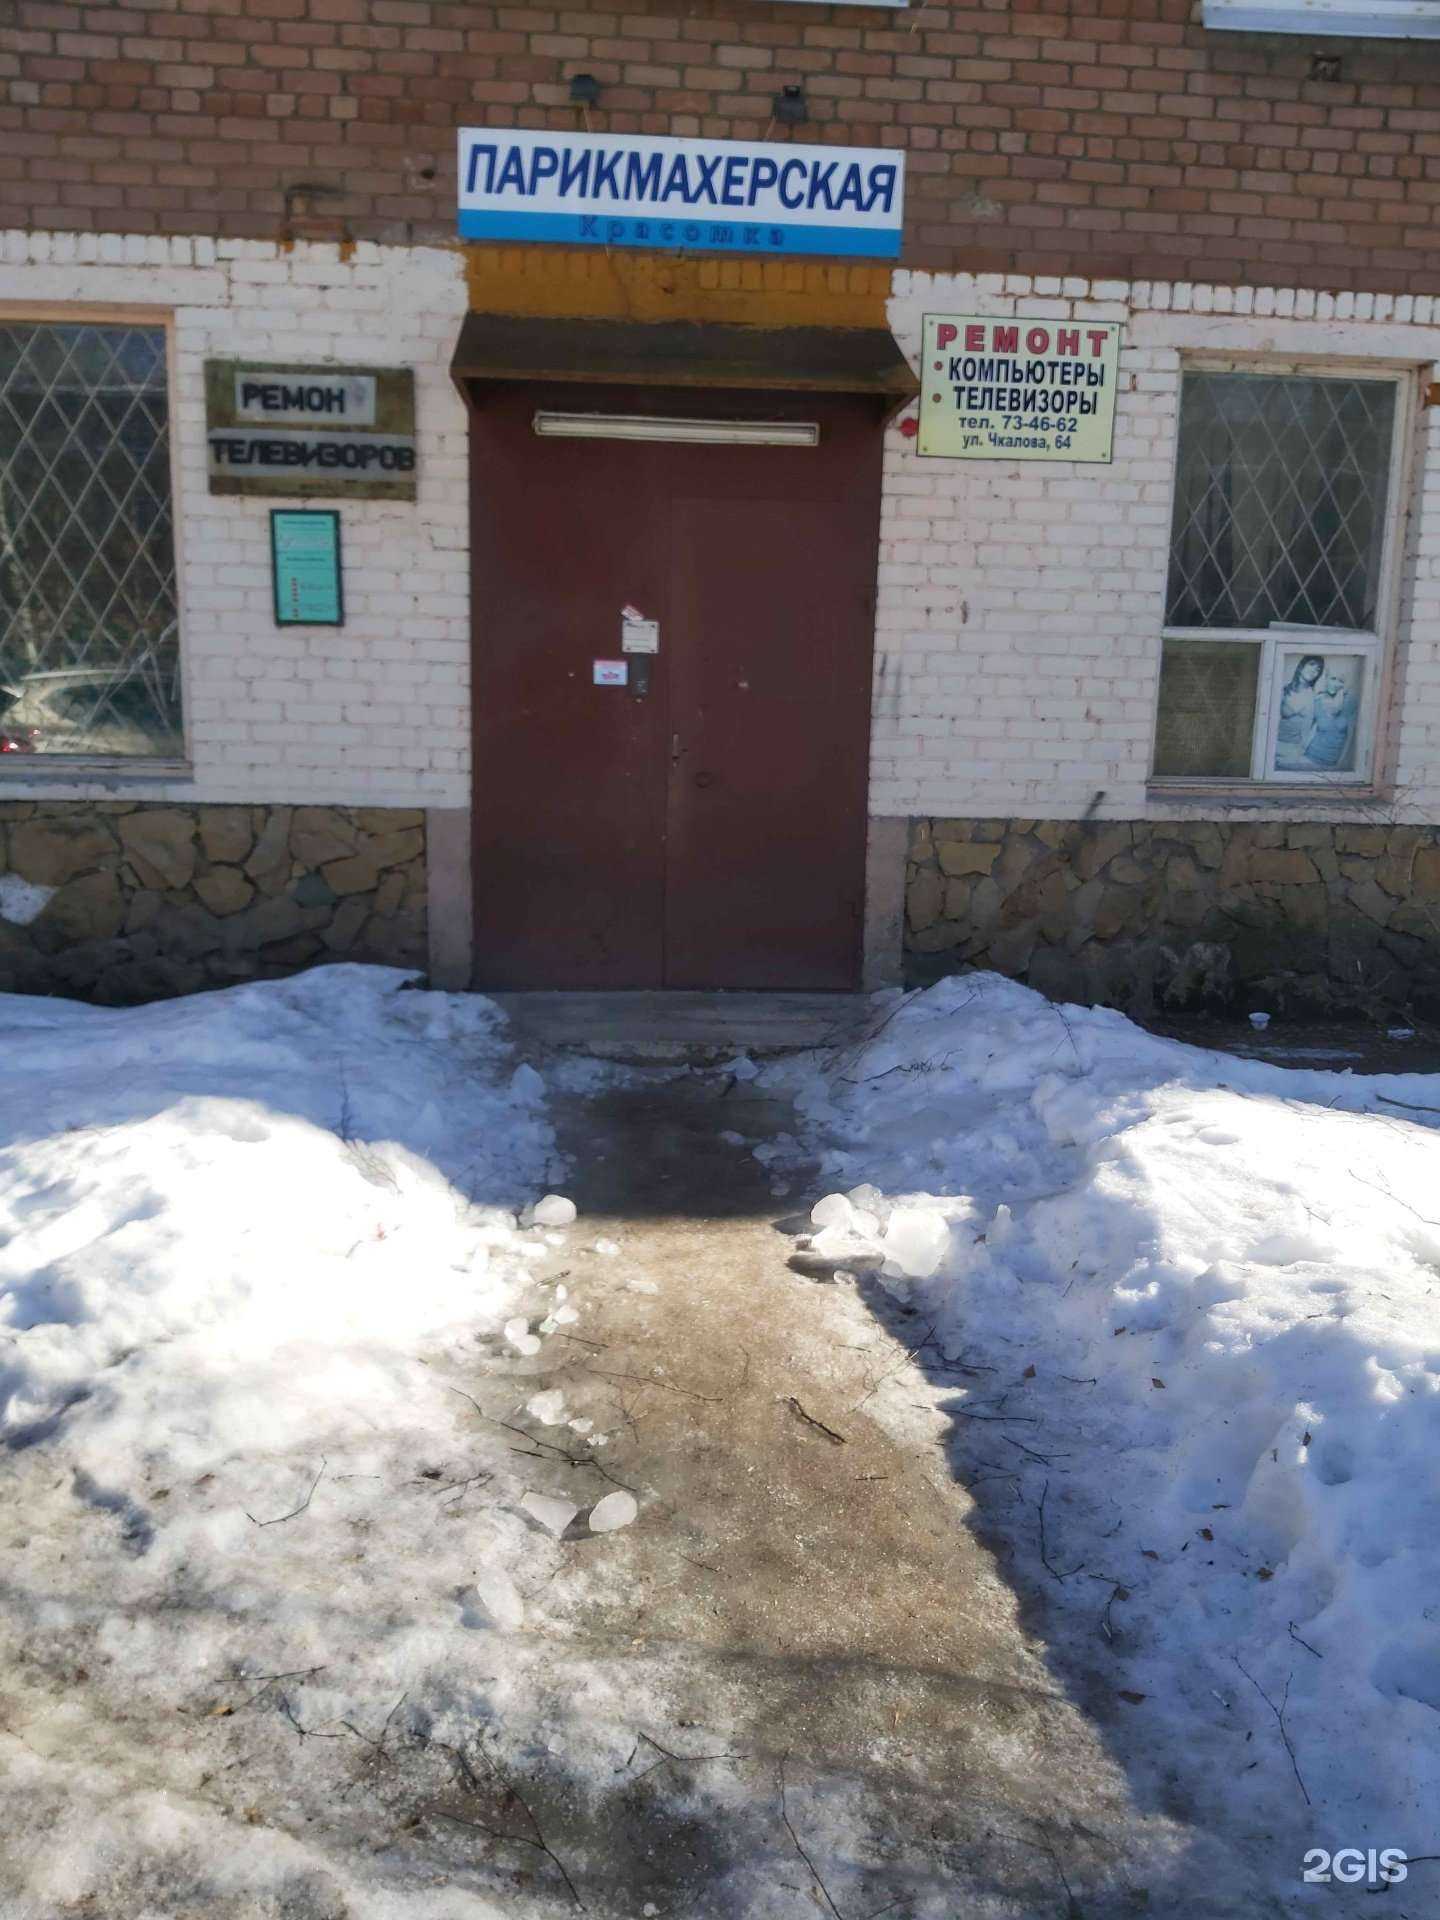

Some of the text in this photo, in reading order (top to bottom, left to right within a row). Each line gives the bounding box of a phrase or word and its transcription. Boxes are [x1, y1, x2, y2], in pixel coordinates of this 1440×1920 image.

[465, 143, 897, 213] ПАРИКМАХЕРСКАЯ
[578, 214, 785, 247] Красотка
[936, 323, 1108, 357] РЕМОНТ
[949, 357, 1105, 387] КОМПЬЮТЕРЫ
[953, 386, 1098, 415] ТЕЛЕВИЗОРЫ
[959, 415, 1078, 433] тел. 73-46-62
[208, 437, 416, 472] ТЕЛЕВИЗОРОВ
[962, 432, 1072, 452] ул. Чкалова, 64
